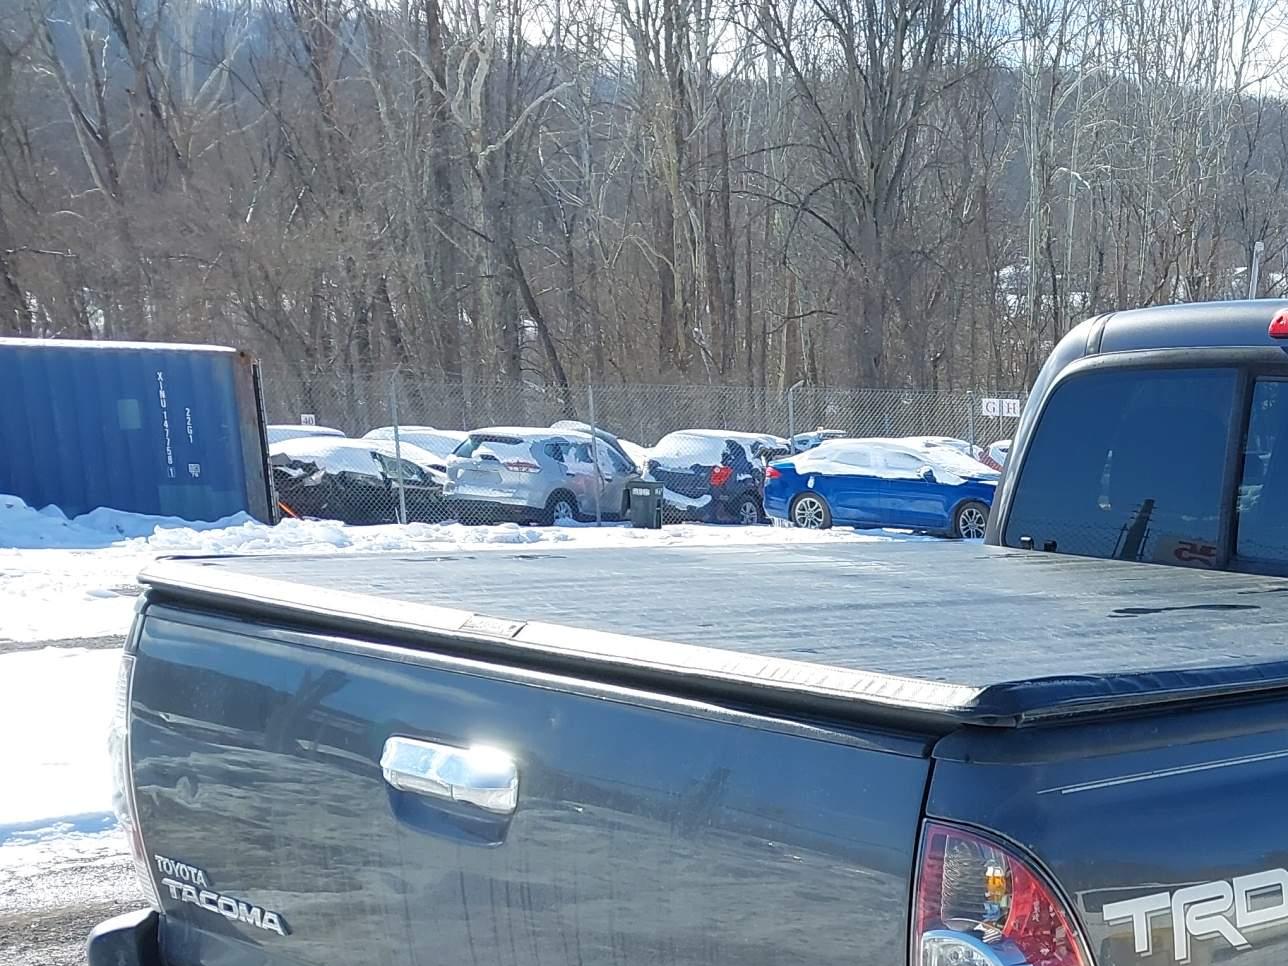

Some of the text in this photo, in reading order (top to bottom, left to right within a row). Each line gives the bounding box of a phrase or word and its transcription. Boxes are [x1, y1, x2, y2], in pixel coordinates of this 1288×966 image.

[157, 371, 167, 408] XINU
[185, 407, 193, 444] 22G1
[154, 854, 208, 888] TOYOTA
[161, 877, 286, 936] TACOMA
